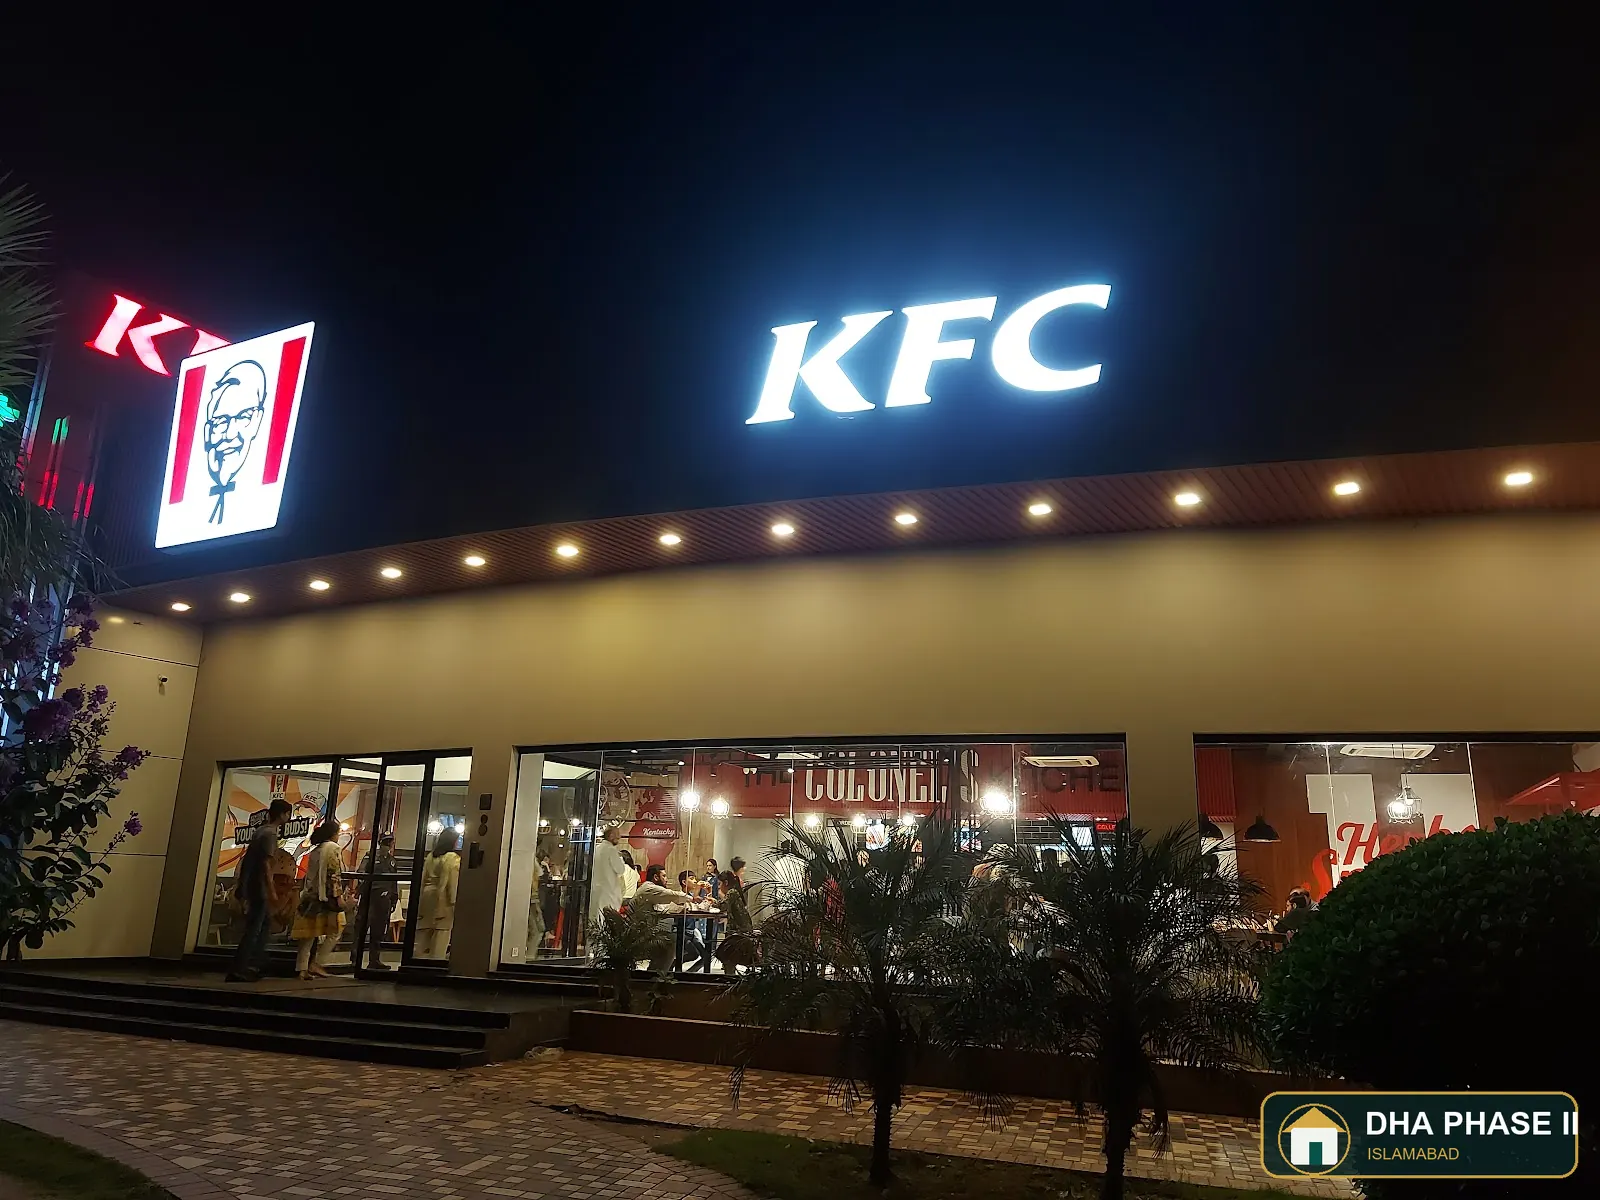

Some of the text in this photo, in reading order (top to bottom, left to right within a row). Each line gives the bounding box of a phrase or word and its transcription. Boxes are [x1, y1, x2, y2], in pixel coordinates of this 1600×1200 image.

[84, 293, 233, 376] K
[745, 284, 1111, 425] KFC
[284, 820, 307, 837] BUDS!
[641, 828, 675, 837] Kentucky
